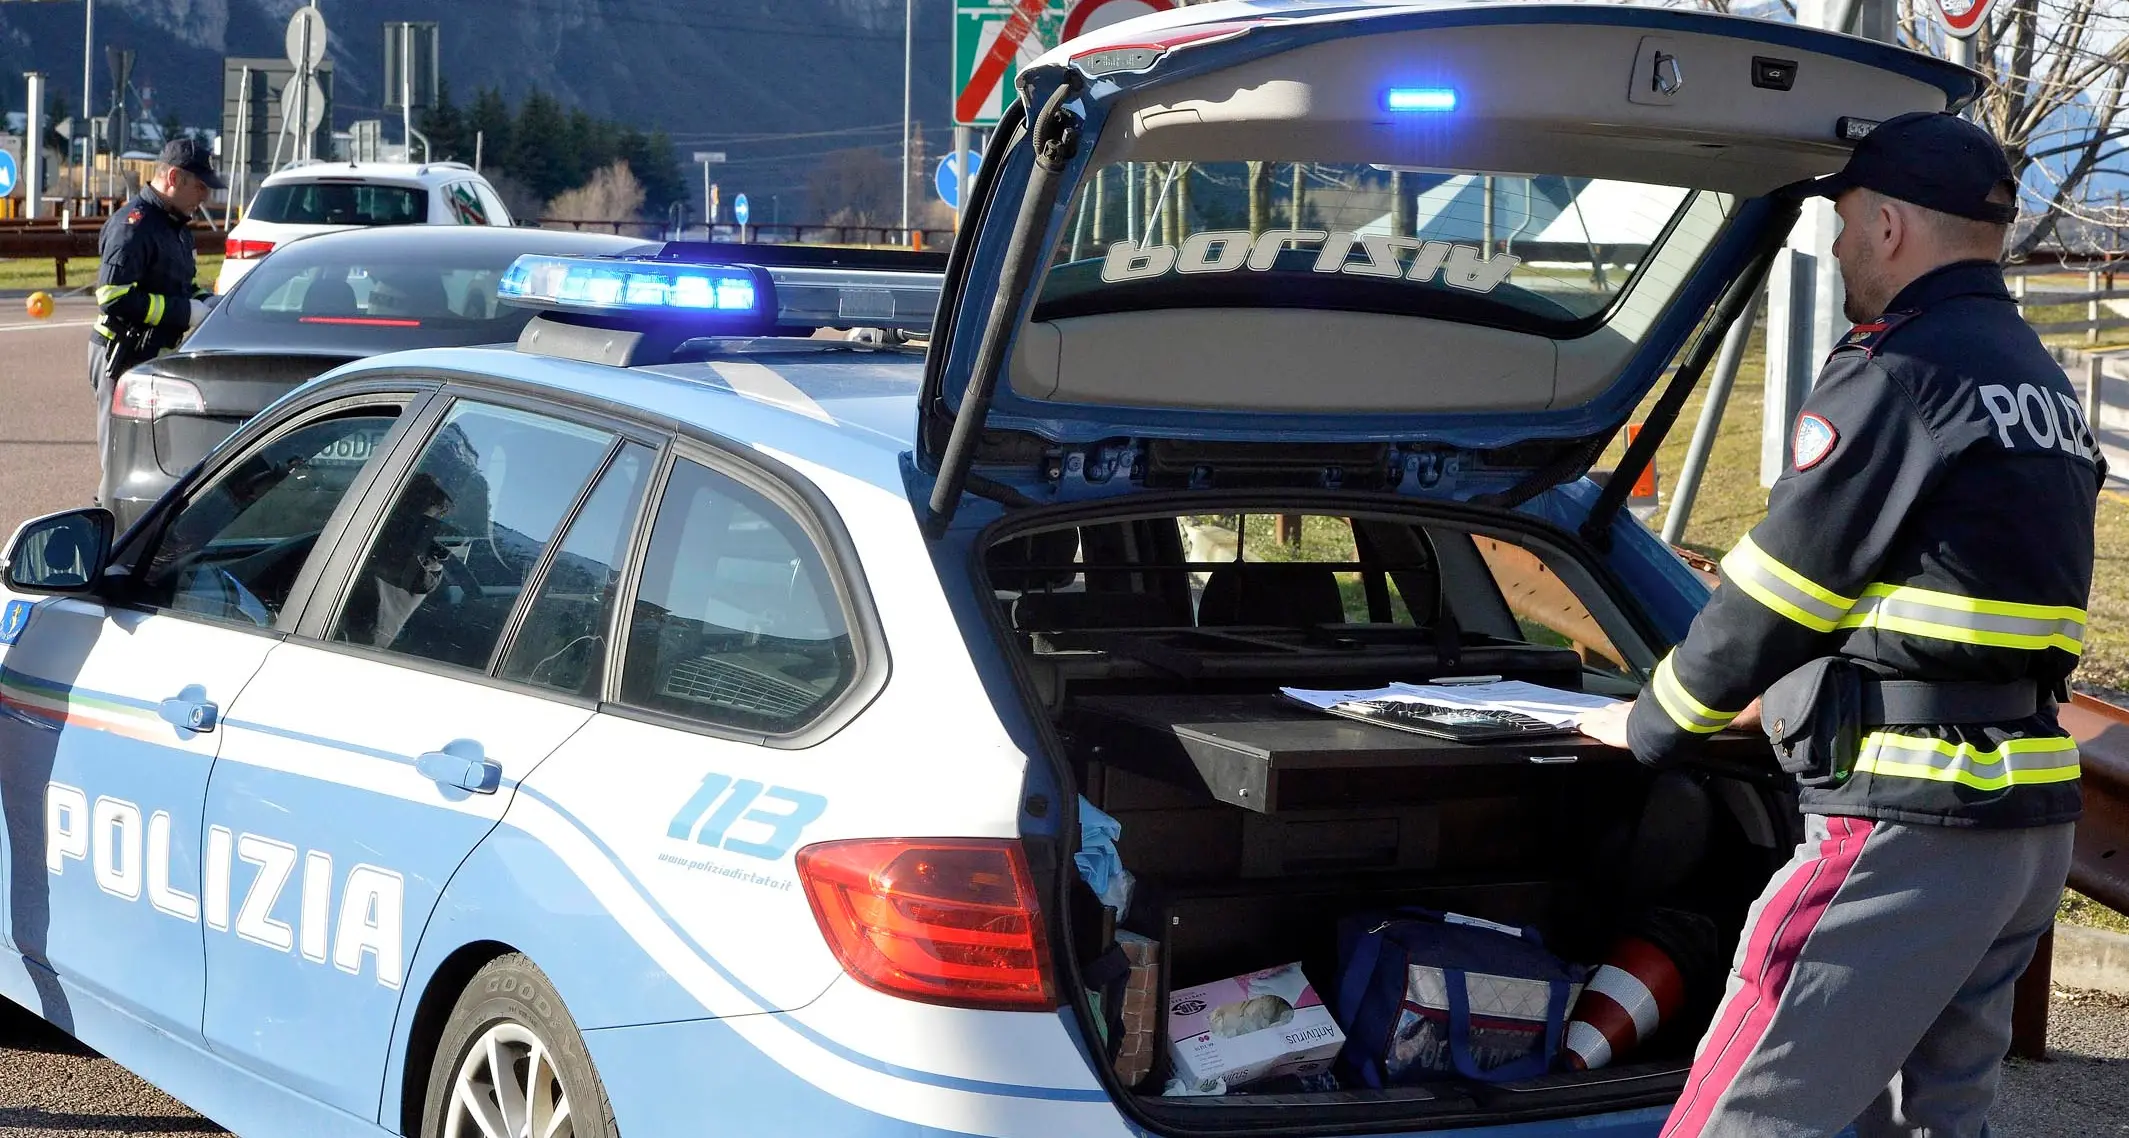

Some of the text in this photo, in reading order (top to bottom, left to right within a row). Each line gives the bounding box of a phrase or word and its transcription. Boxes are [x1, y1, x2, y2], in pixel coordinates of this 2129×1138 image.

[666, 772, 828, 861] 113
[43, 780, 404, 990] POLIZIA
[658, 852, 793, 892] www.poliziadistato.it
[1285, 1024, 1335, 1044] Antivirus
